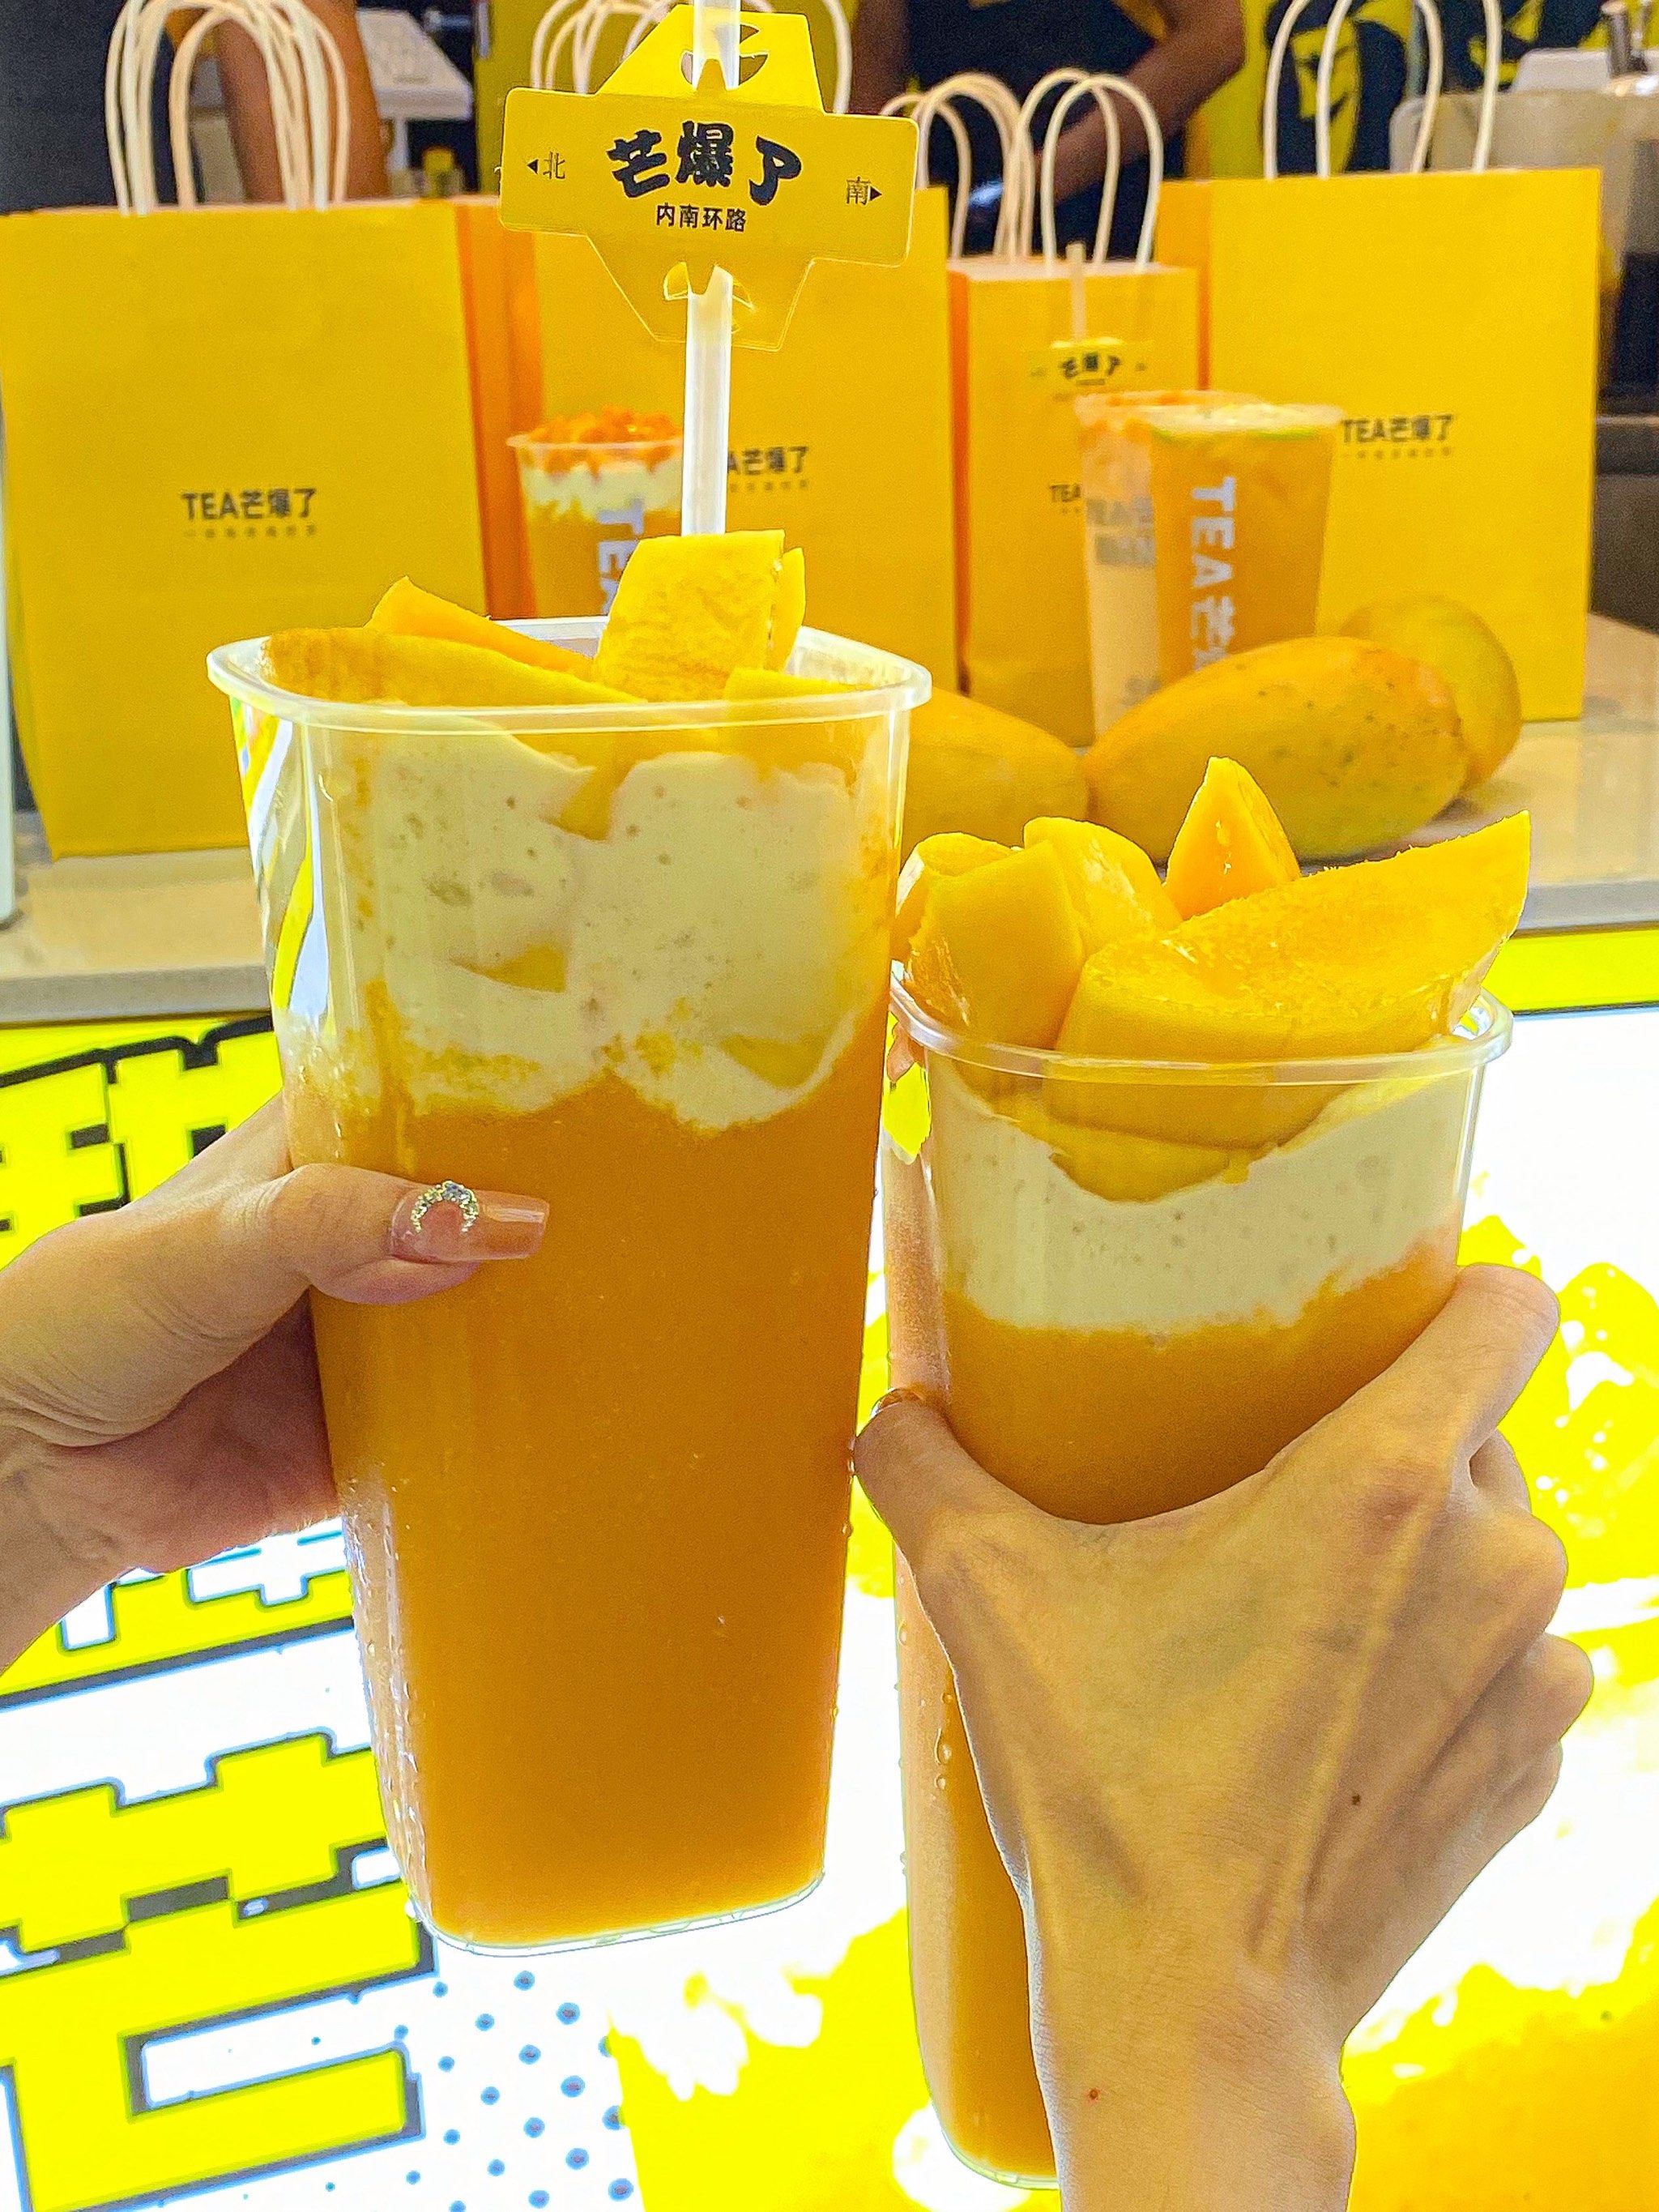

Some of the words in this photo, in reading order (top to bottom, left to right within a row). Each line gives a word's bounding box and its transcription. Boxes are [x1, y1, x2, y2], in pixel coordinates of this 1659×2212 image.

[542, 152, 566, 180] 北
[607, 121, 803, 206] 芒爆了
[845, 176, 872, 206] 南
[655, 203, 747, 233] 内南环路
